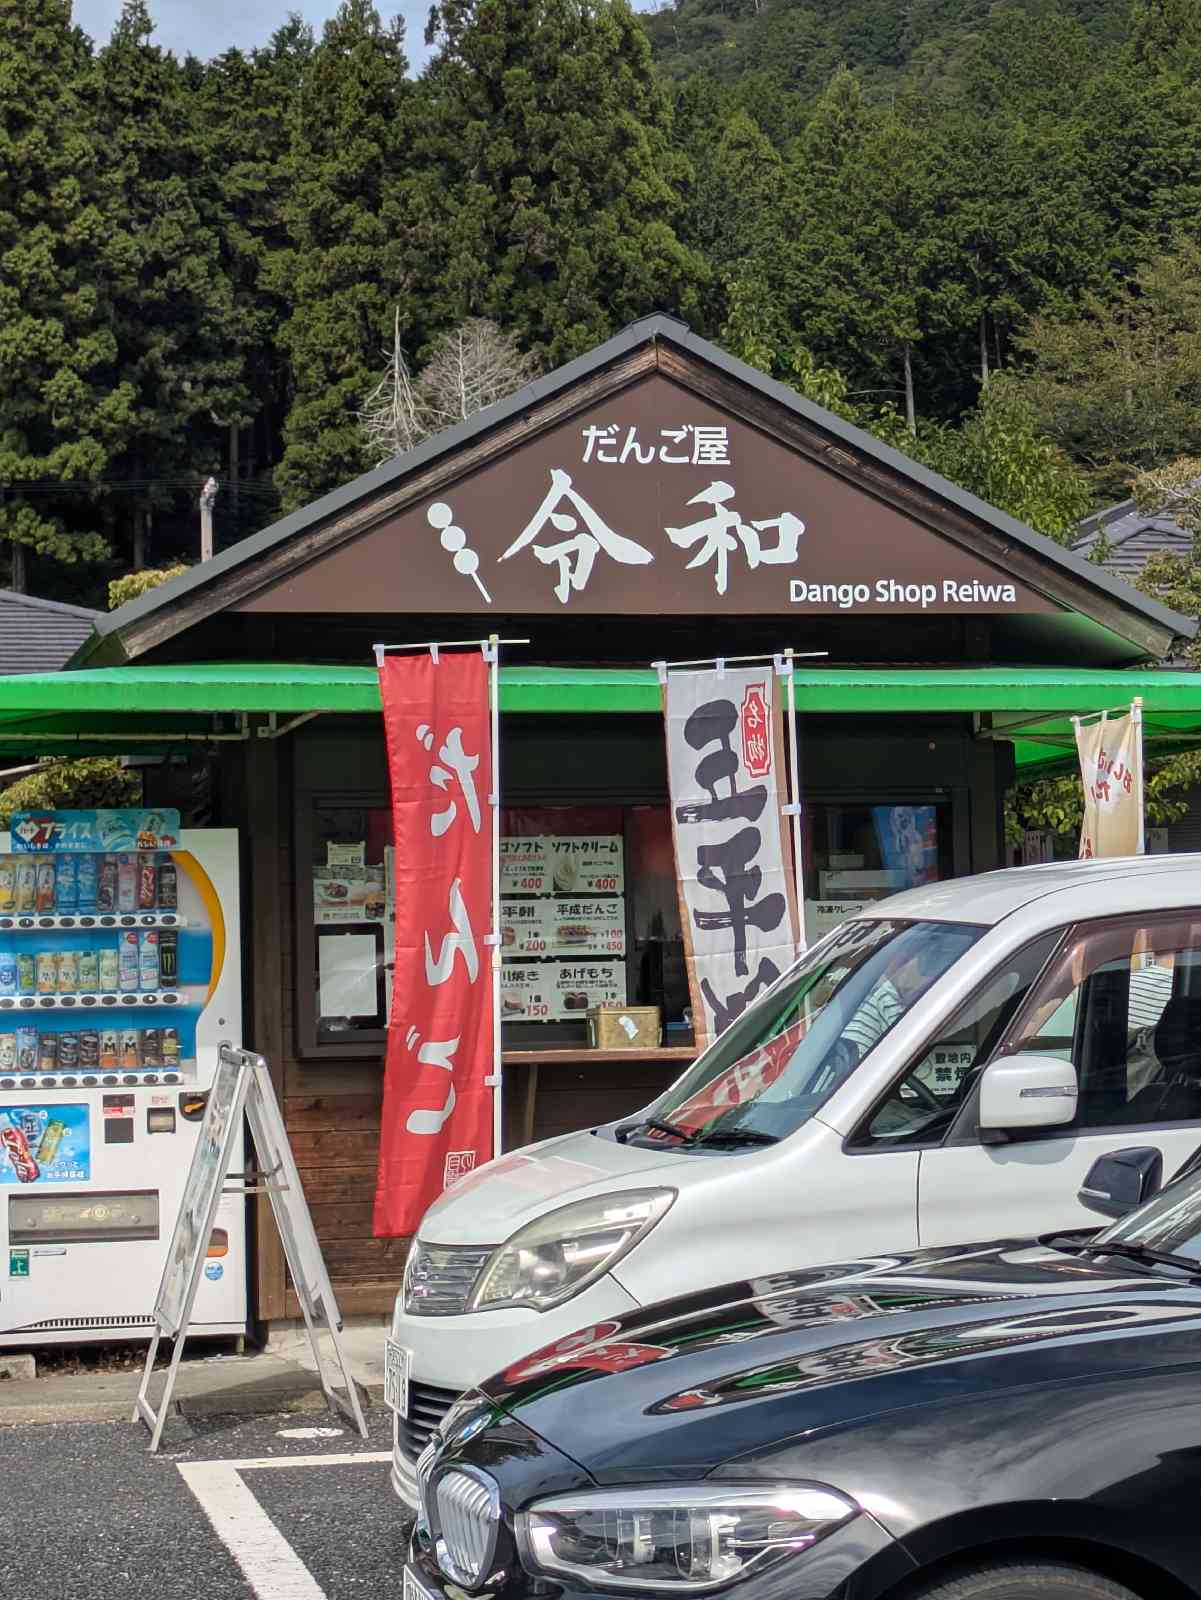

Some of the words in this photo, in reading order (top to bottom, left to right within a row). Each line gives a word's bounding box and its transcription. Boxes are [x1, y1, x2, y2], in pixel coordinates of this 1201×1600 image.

[581, 424, 730, 465] だんご屋
[497, 468, 806, 603] 令和
[790, 580, 870, 608] Dango
[875, 580, 937, 608] Shop
[944, 580, 1017, 603] Reiwa
[552, 841, 619, 853] ソフトクリーム
[559, 968, 614, 979] あげもち
